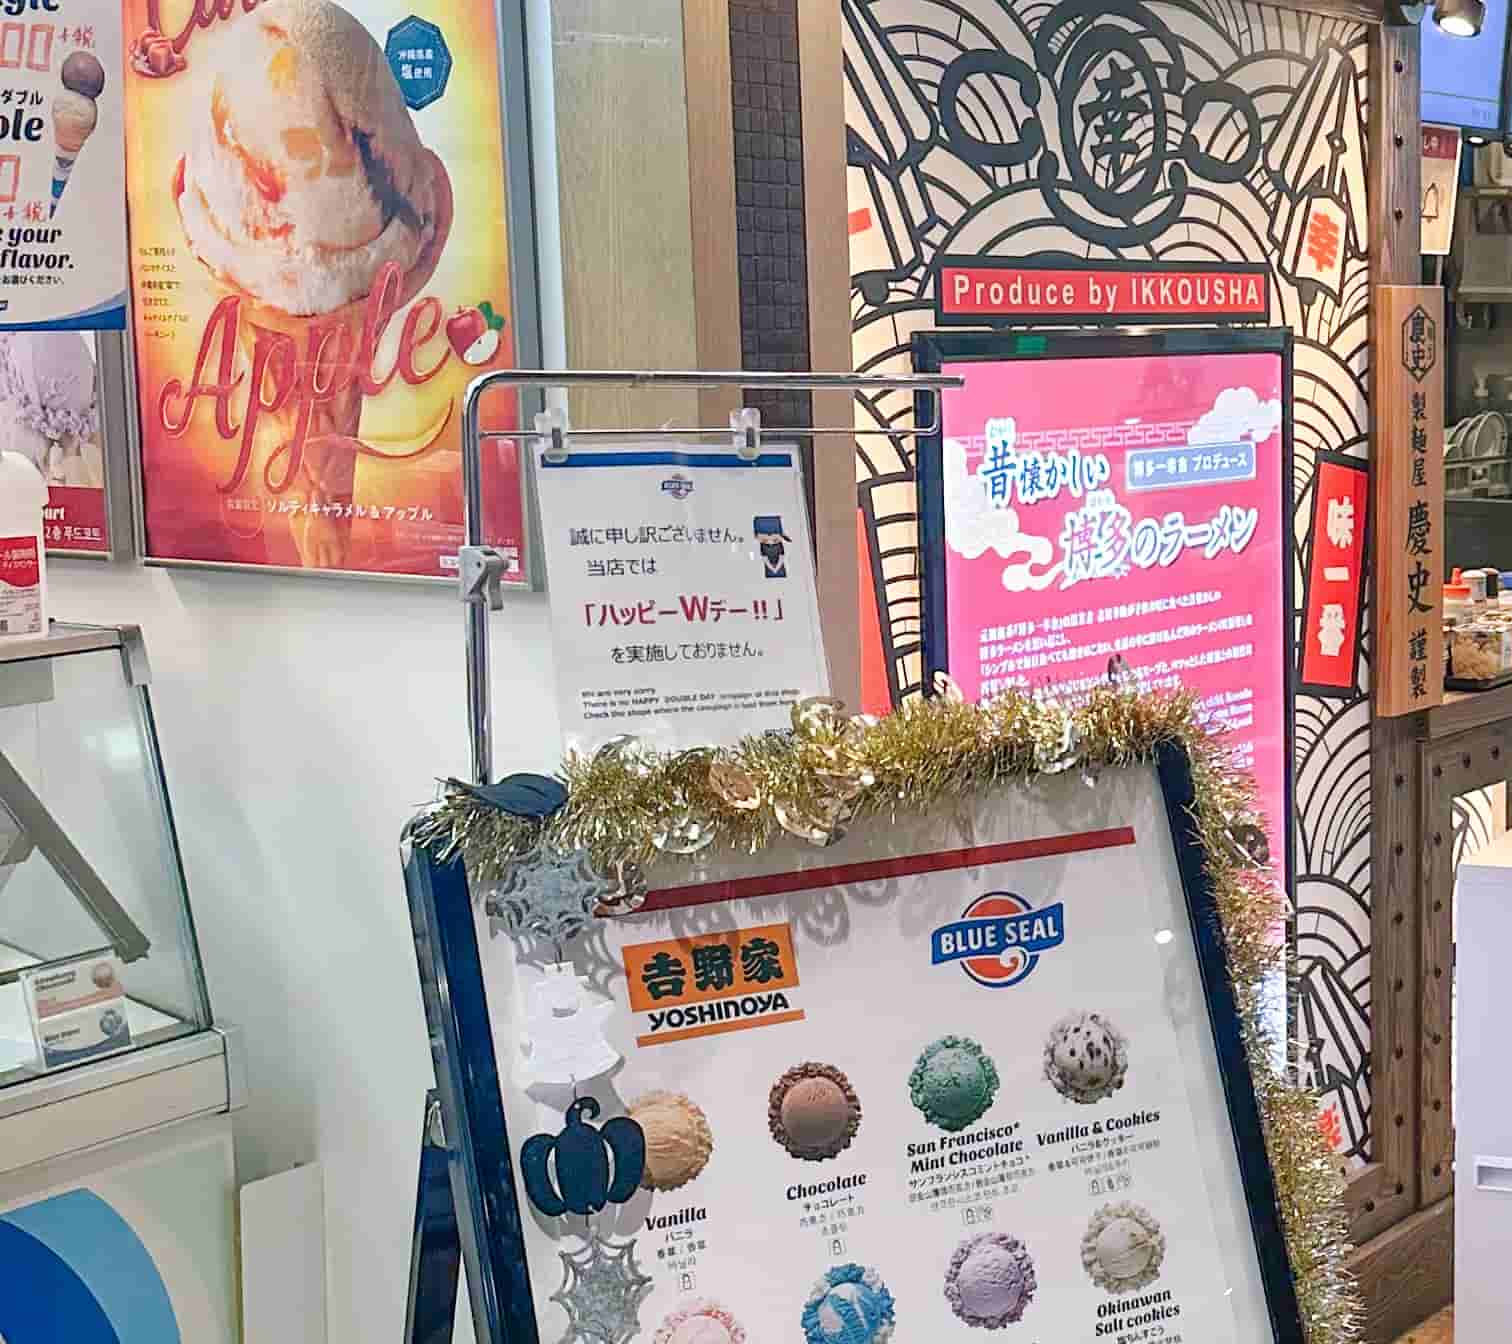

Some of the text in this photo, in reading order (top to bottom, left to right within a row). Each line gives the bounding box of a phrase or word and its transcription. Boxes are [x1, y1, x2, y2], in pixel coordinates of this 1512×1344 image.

[8, 227, 62, 247] your
[953, 274, 1260, 312] Produce by IKKOUSHA
[158, 261, 453, 495] Apple
[980, 439, 1108, 505] 昔懐かしい
[570, 525, 745, 546] 誠に申し訳ございません。
[586, 558, 658, 576] 当店では
[611, 639, 764, 664] を実施しておりません。
[940, 914, 1060, 956] BLUE SEAL
[1036, 1110, 1161, 1147] Vanilla & Cookies
[906, 1141, 937, 1158] San
[911, 1156, 945, 1174] Mint
[948, 1139, 1024, 1166] Chocolate
[786, 1173, 867, 1201] Chocolate
[644, 1206, 707, 1232] Vanilla
[1096, 1289, 1172, 1319] Okinawan
[1095, 1304, 1181, 1337] Salt cookies
